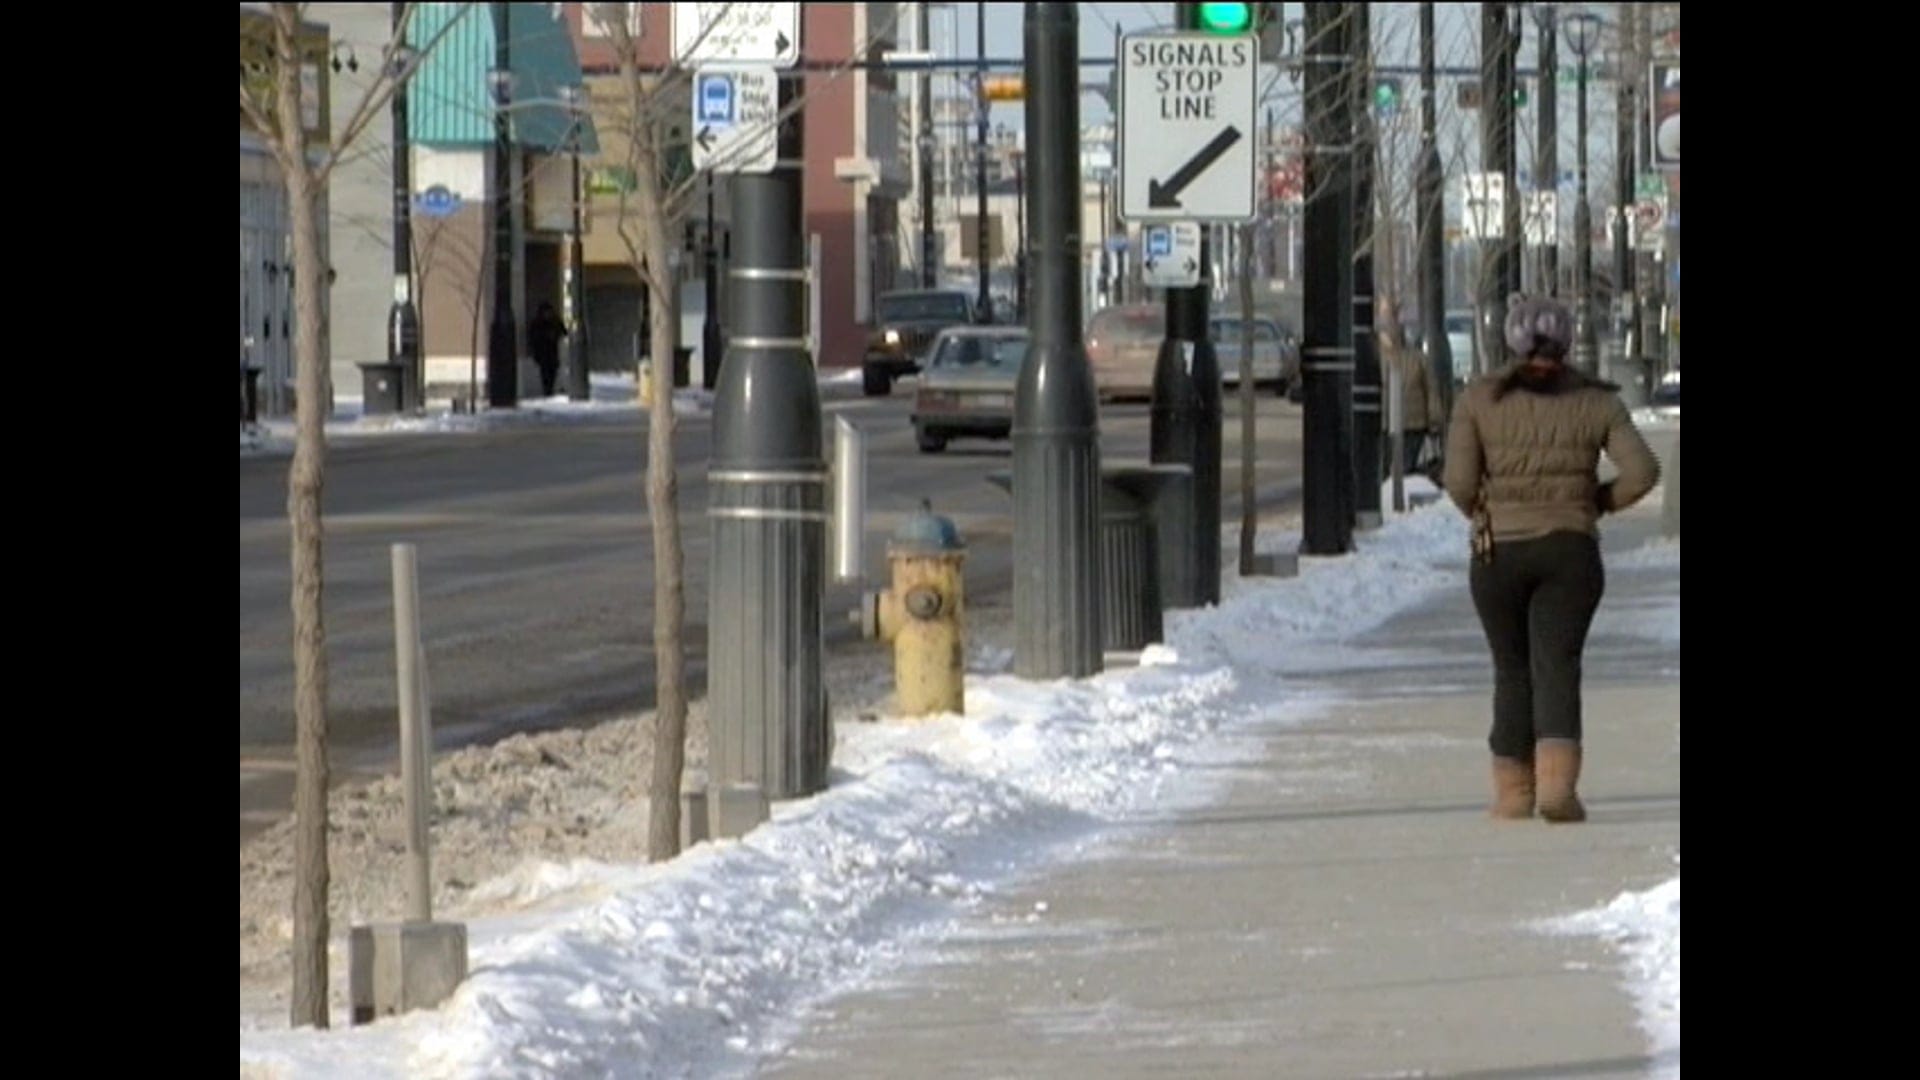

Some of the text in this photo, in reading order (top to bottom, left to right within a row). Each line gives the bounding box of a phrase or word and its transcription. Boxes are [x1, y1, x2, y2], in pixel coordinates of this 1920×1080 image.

[1132, 42, 1246, 67] SIGNALS
[741, 73, 764, 86] Bus
[1156, 69, 1222, 92] STOP
[741, 90, 769, 106] Stop
[1161, 95, 1216, 119] LINE
